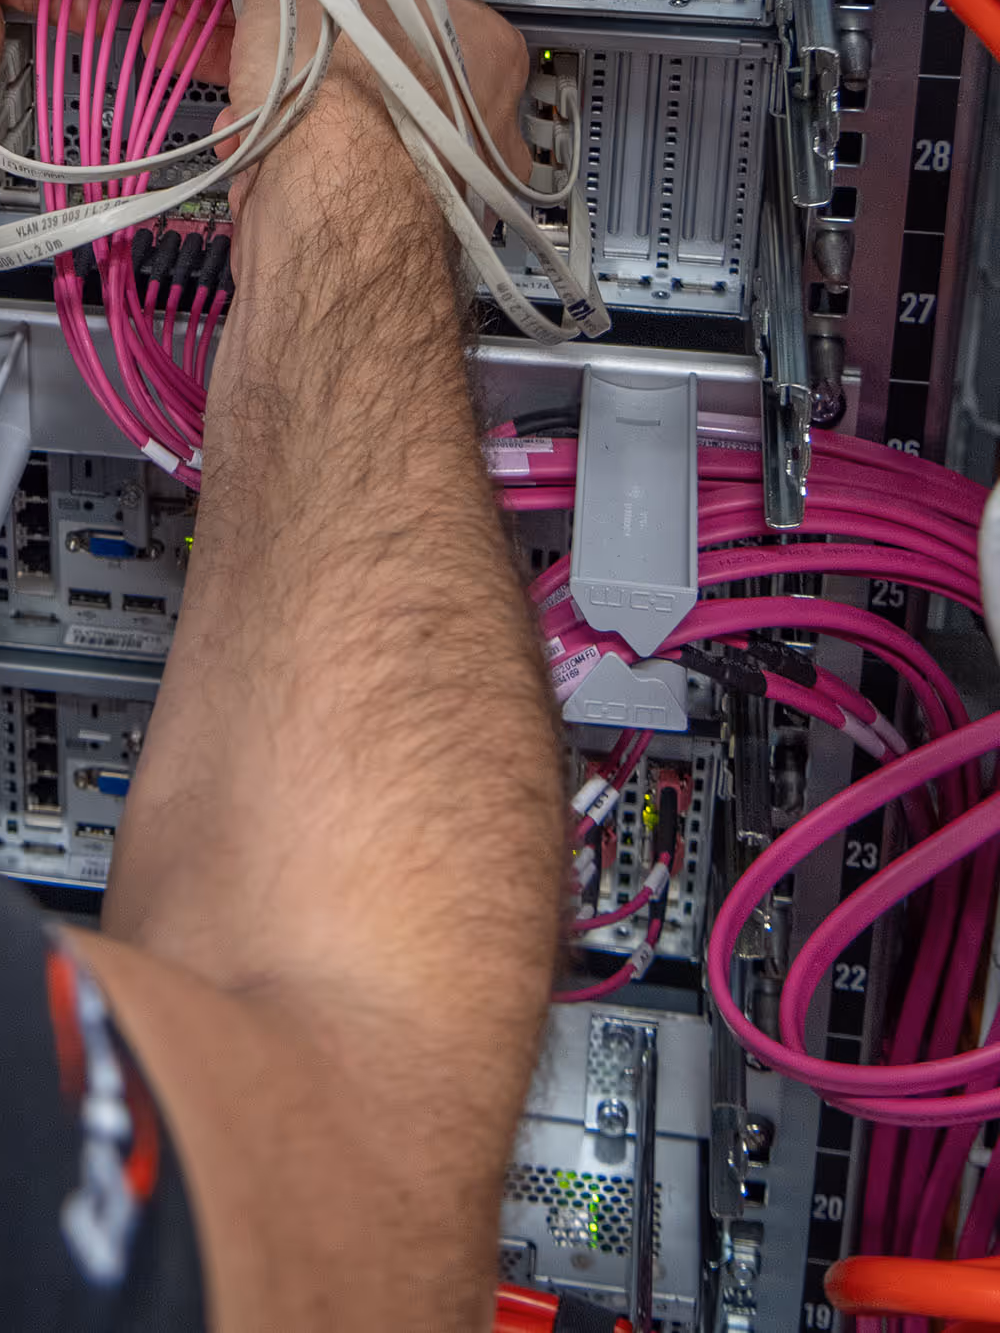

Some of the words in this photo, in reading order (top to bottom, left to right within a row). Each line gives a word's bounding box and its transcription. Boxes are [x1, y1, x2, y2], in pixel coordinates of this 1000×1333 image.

[913, 139, 951, 172] 28
[16, 222, 40, 238] VLAN
[41, 215, 59, 231] 239
[23, 238, 63, 261] L:2.0m
[899, 293, 936, 325] 27
[871, 579, 904, 608] 25
[846, 840, 879, 869] 23
[835, 963, 866, 992] 22
[813, 1196, 843, 1222] 20
[804, 1304, 832, 1331] 19
